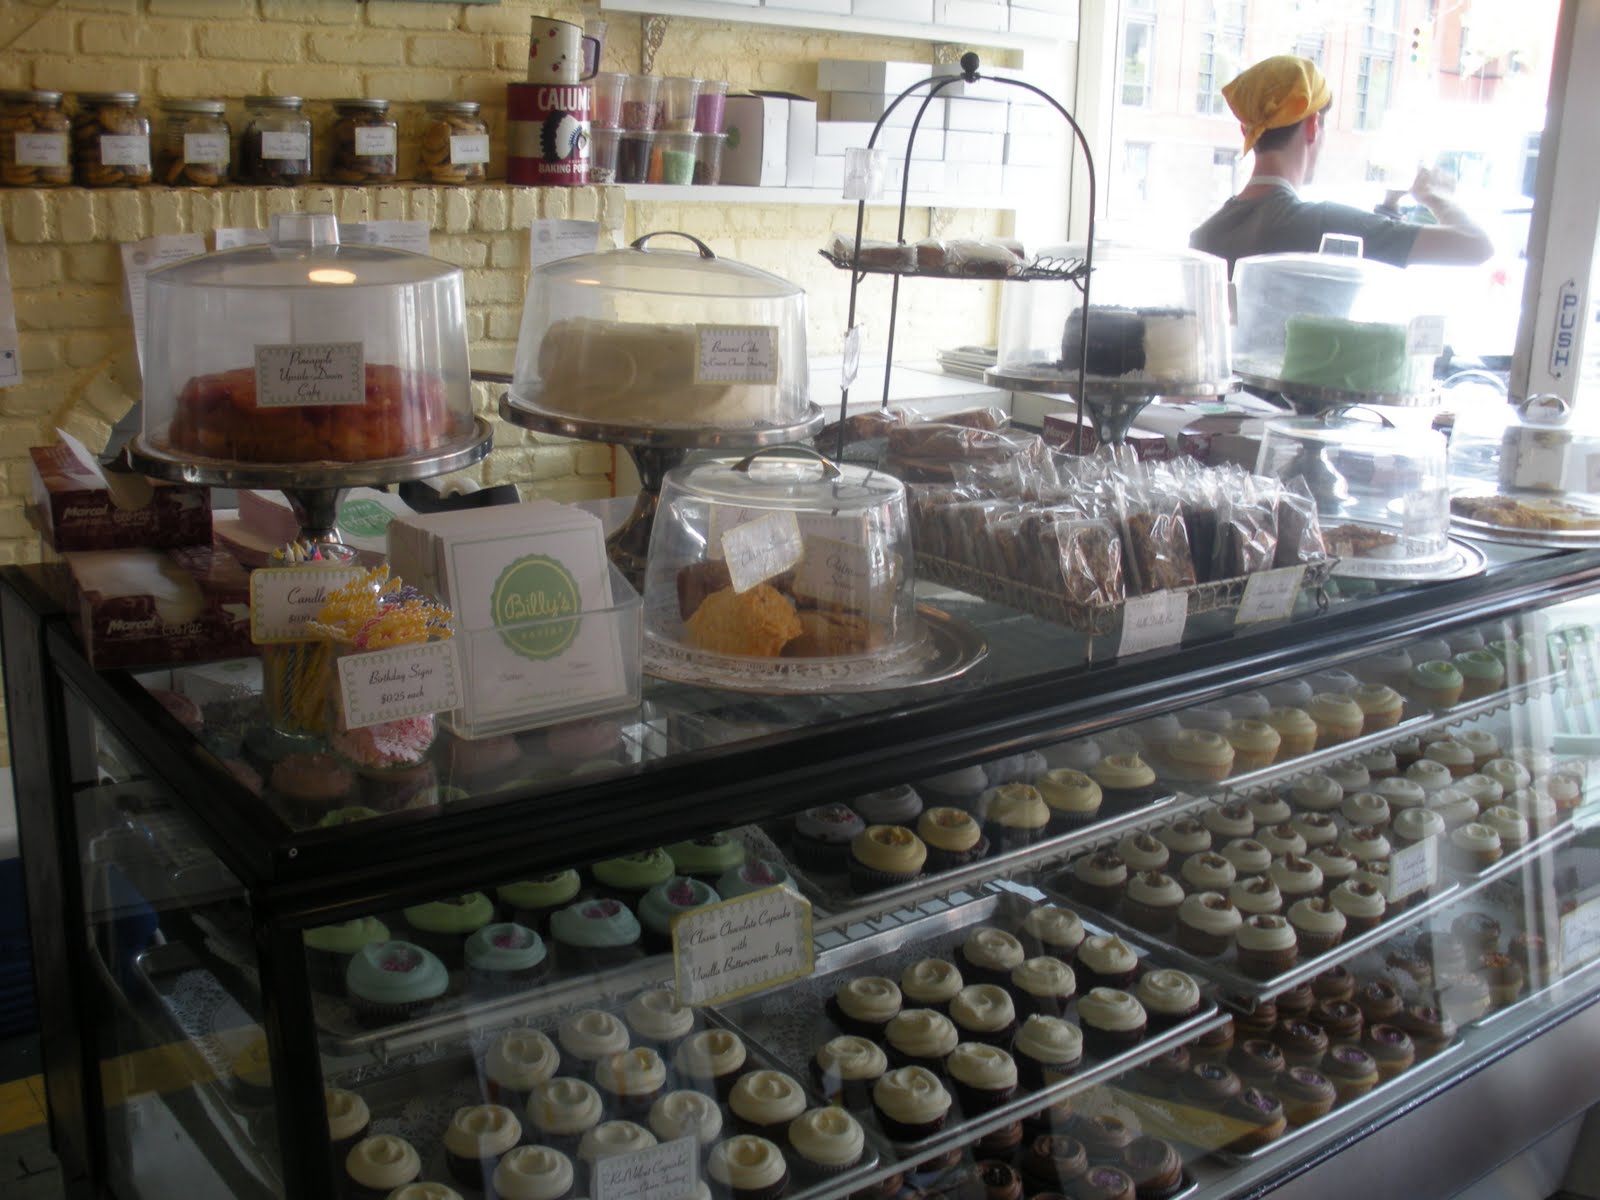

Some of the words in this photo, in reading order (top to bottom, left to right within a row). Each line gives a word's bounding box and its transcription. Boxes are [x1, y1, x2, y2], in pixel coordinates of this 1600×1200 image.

[538, 163, 571, 174] BAKING
[1554, 295, 1578, 366] PUSH
[505, 590, 572, 620] Billy's
[369, 667, 405, 685] Birthday
[408, 663, 433, 679] Signs
[407, 686, 424, 700] each
[720, 914, 756, 937] Chocolate
[731, 936, 748, 953] with
[690, 962, 720, 981] Vanilla
[723, 954, 769, 972] Buttercream
[770, 942, 793, 958] Icing
